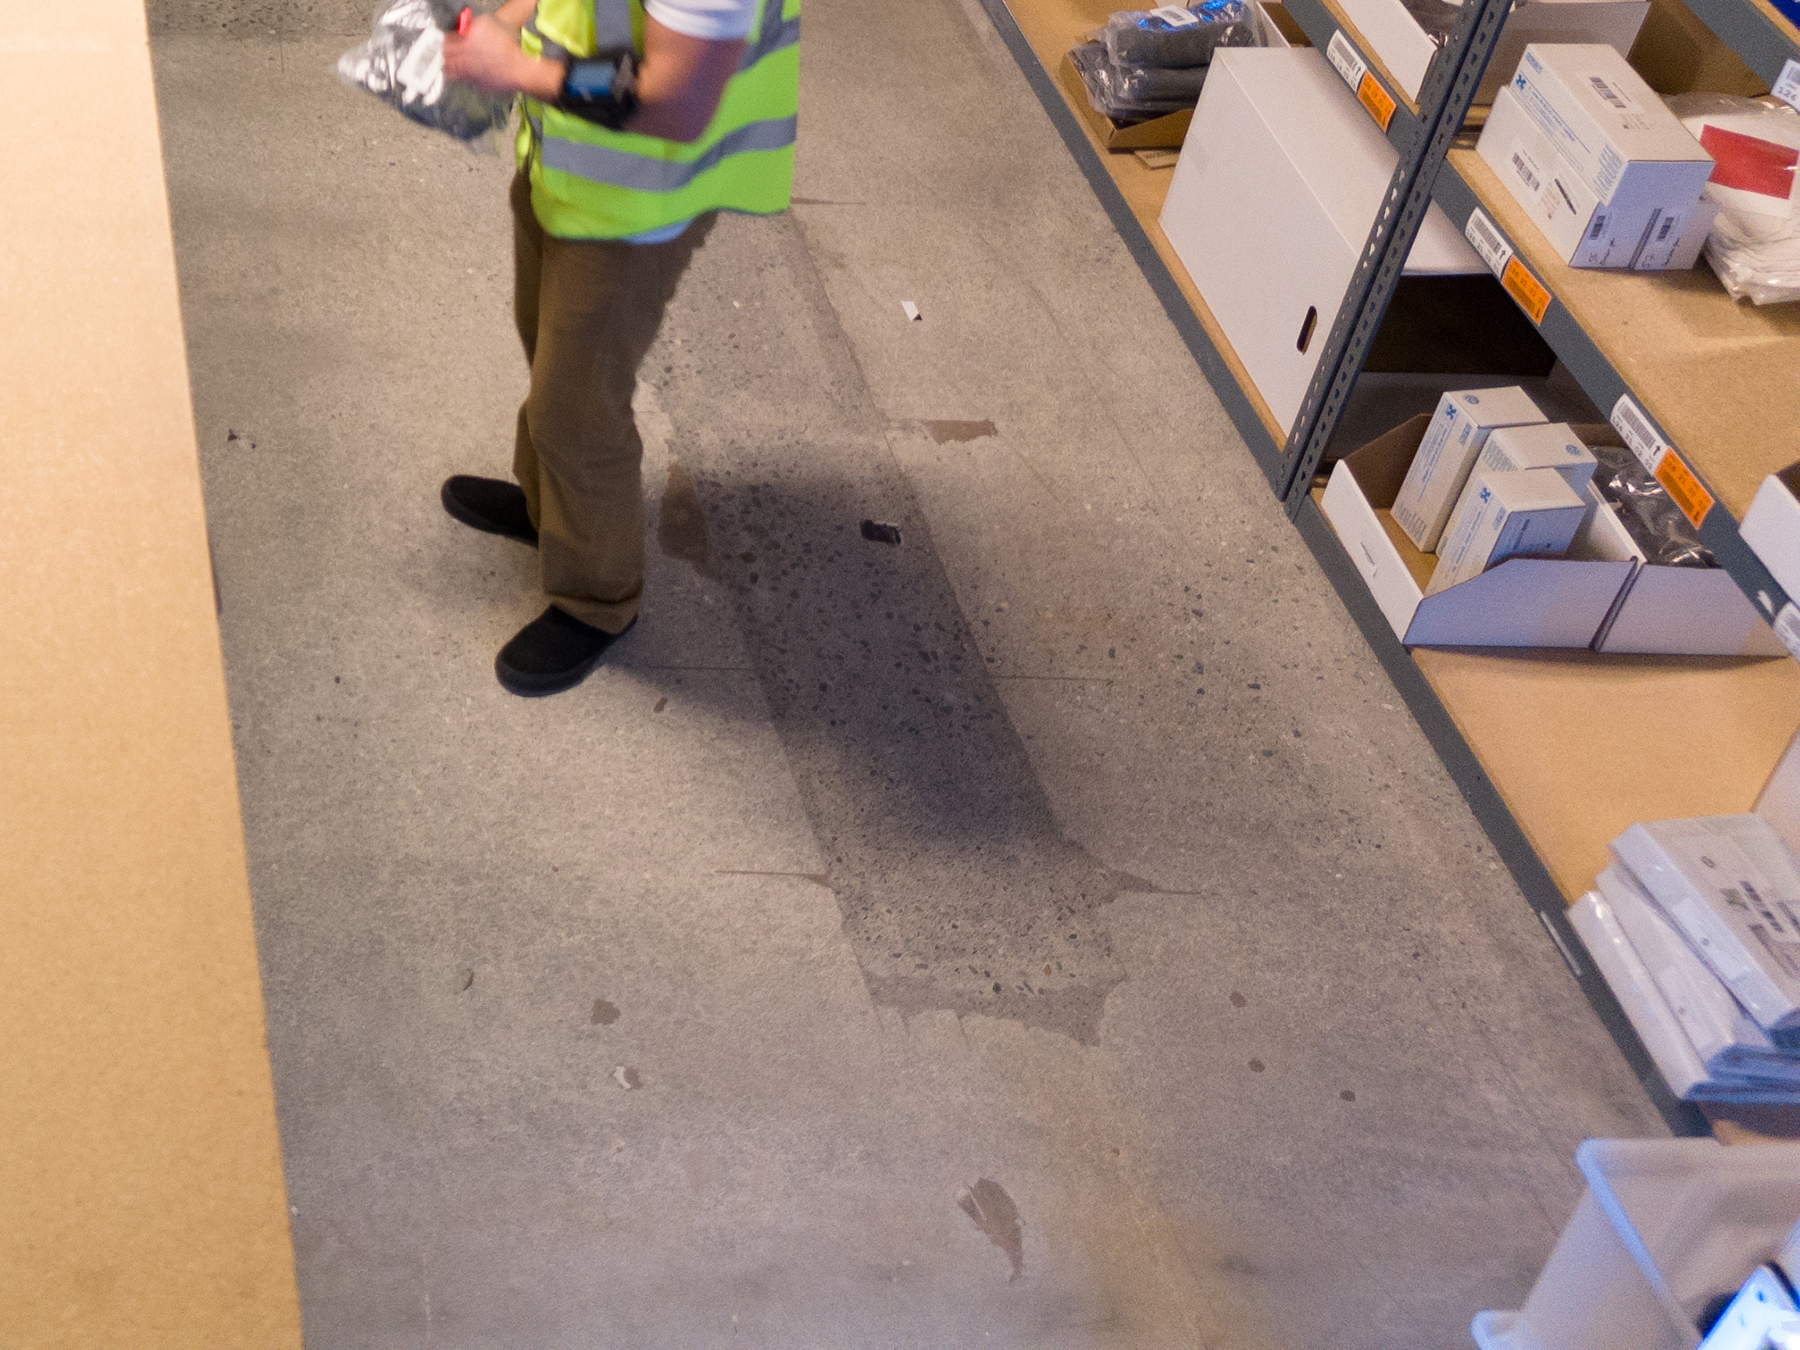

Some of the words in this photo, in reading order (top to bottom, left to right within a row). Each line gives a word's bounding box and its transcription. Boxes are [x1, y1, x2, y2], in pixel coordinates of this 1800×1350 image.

[1777, 87, 1797, 102] 126
[1466, 228, 1476, 242] 126
[1612, 416, 1623, 432] 126
[1625, 433, 1633, 444] 21
[1634, 445, 1643, 456] 02
[1644, 457, 1653, 469] 02
[1663, 457, 1675, 473] 126
